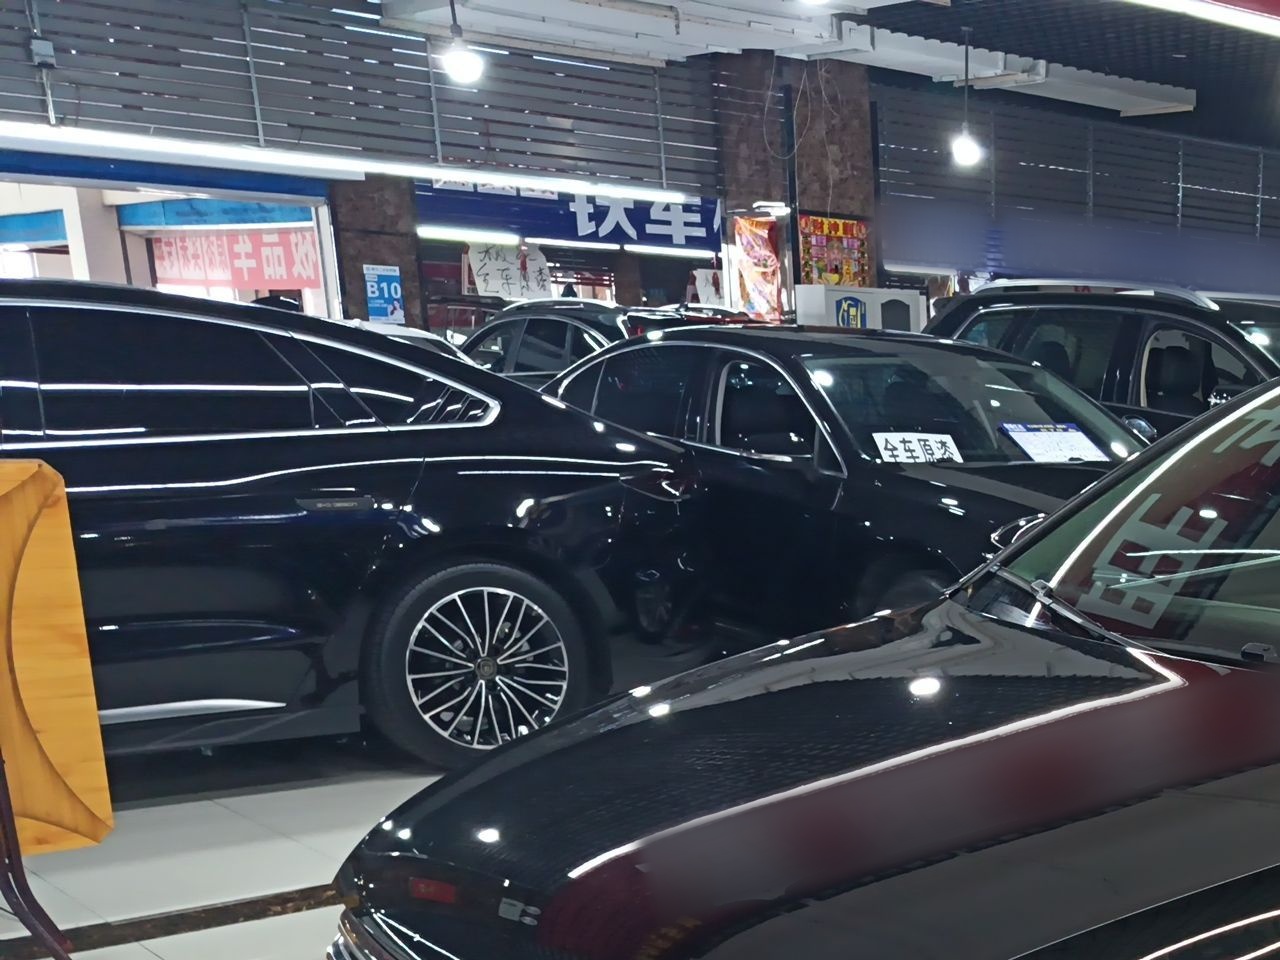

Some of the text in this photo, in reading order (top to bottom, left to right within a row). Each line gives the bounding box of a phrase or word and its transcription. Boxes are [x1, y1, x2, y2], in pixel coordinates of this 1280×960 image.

[569, 194, 721, 245] 铁车
[366, 281, 402, 299] B10
[883, 438, 956, 463] 全车原漆
